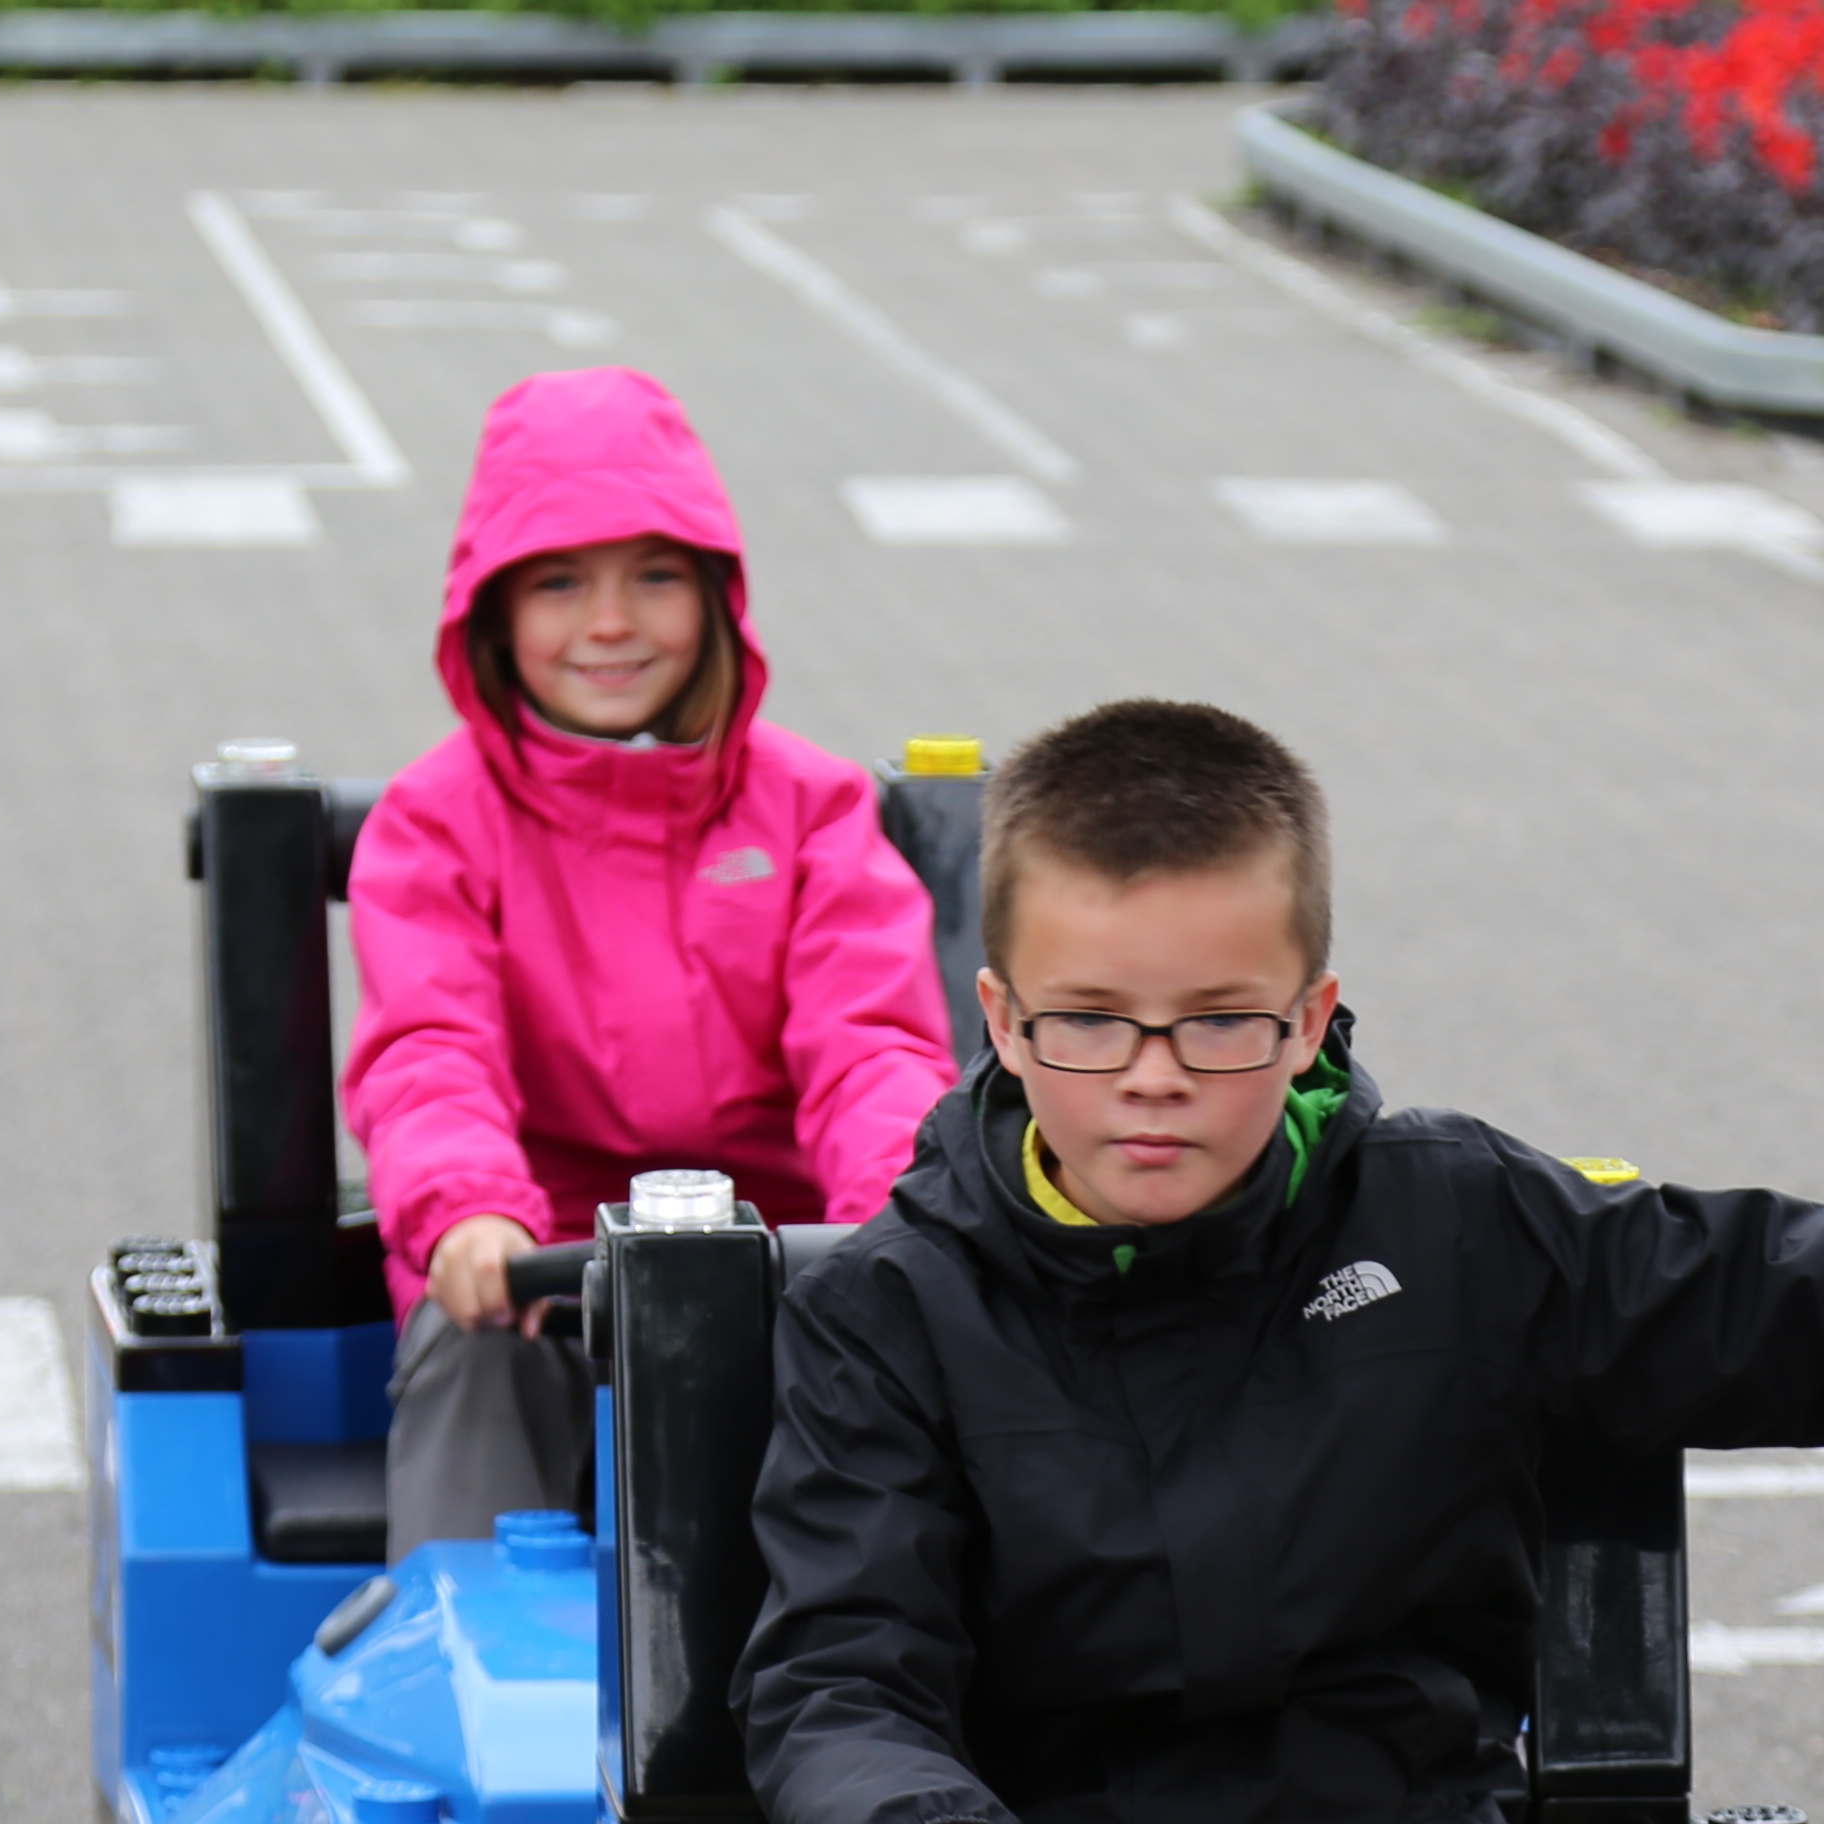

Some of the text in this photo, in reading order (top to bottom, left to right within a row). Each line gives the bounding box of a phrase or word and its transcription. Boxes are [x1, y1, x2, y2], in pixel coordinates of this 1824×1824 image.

[1319, 1264, 1355, 1290] THE
[1302, 1277, 1365, 1320] NORTH
[1324, 1290, 1370, 1322] FACE
